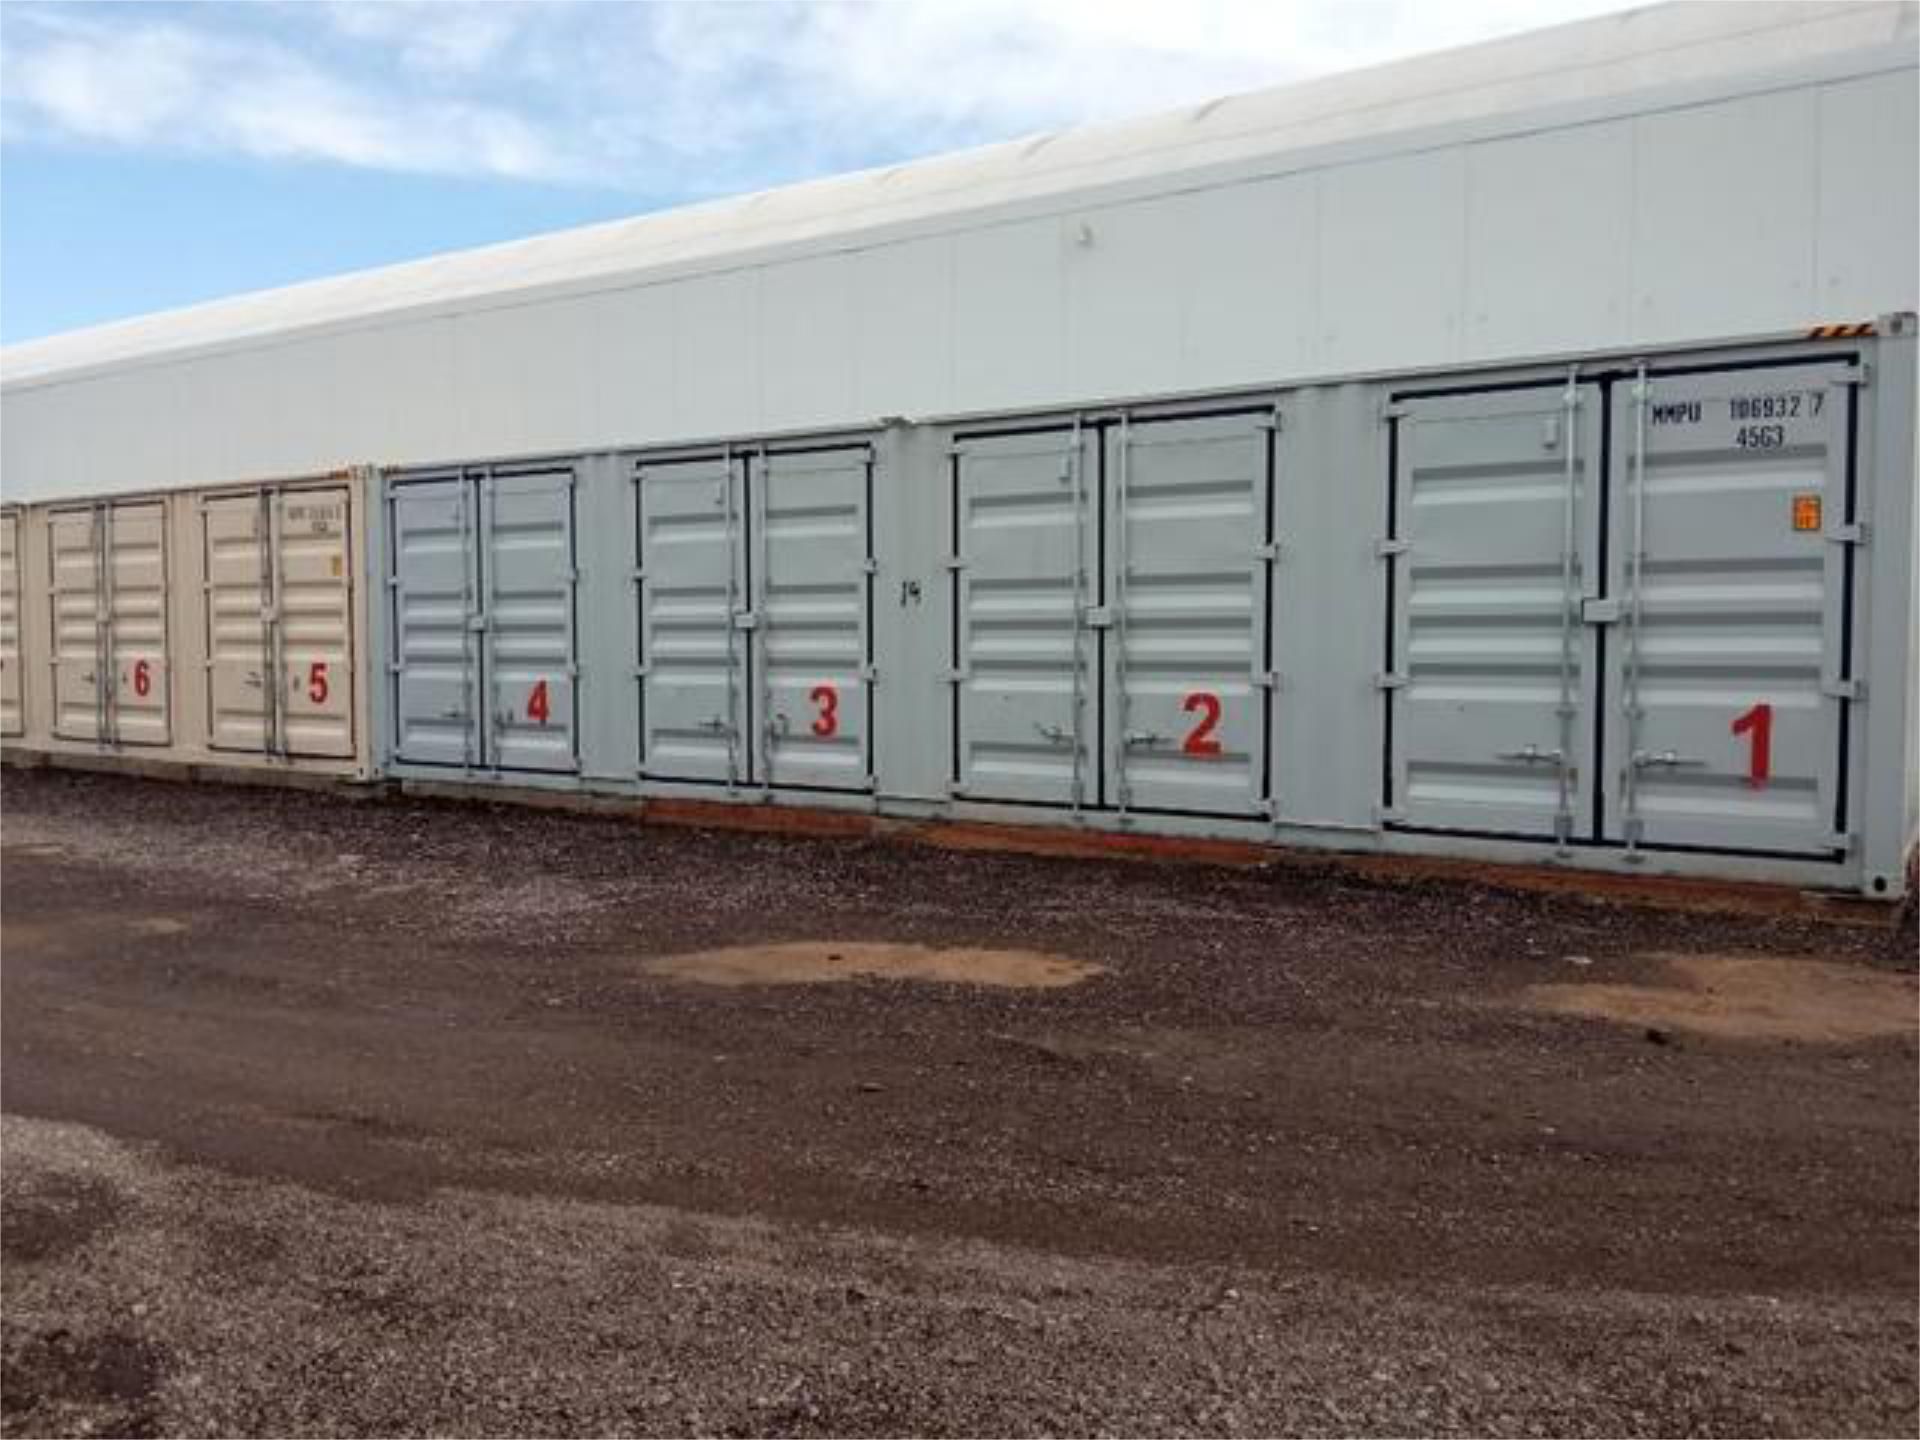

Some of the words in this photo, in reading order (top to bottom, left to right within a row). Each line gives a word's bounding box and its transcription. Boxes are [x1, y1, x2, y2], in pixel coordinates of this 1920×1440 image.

[1652, 401, 1702, 426] MMPU
[1729, 395, 1801, 420] 106932
[1811, 391, 1825, 416] 7
[1736, 425, 1784, 448] 45G3
[133, 662, 151, 697] 6
[309, 663, 328, 703] 5
[526, 680, 550, 726] 4
[810, 685, 838, 736] 3
[1182, 692, 1222, 754] 2
[1731, 704, 1774, 790] 1
